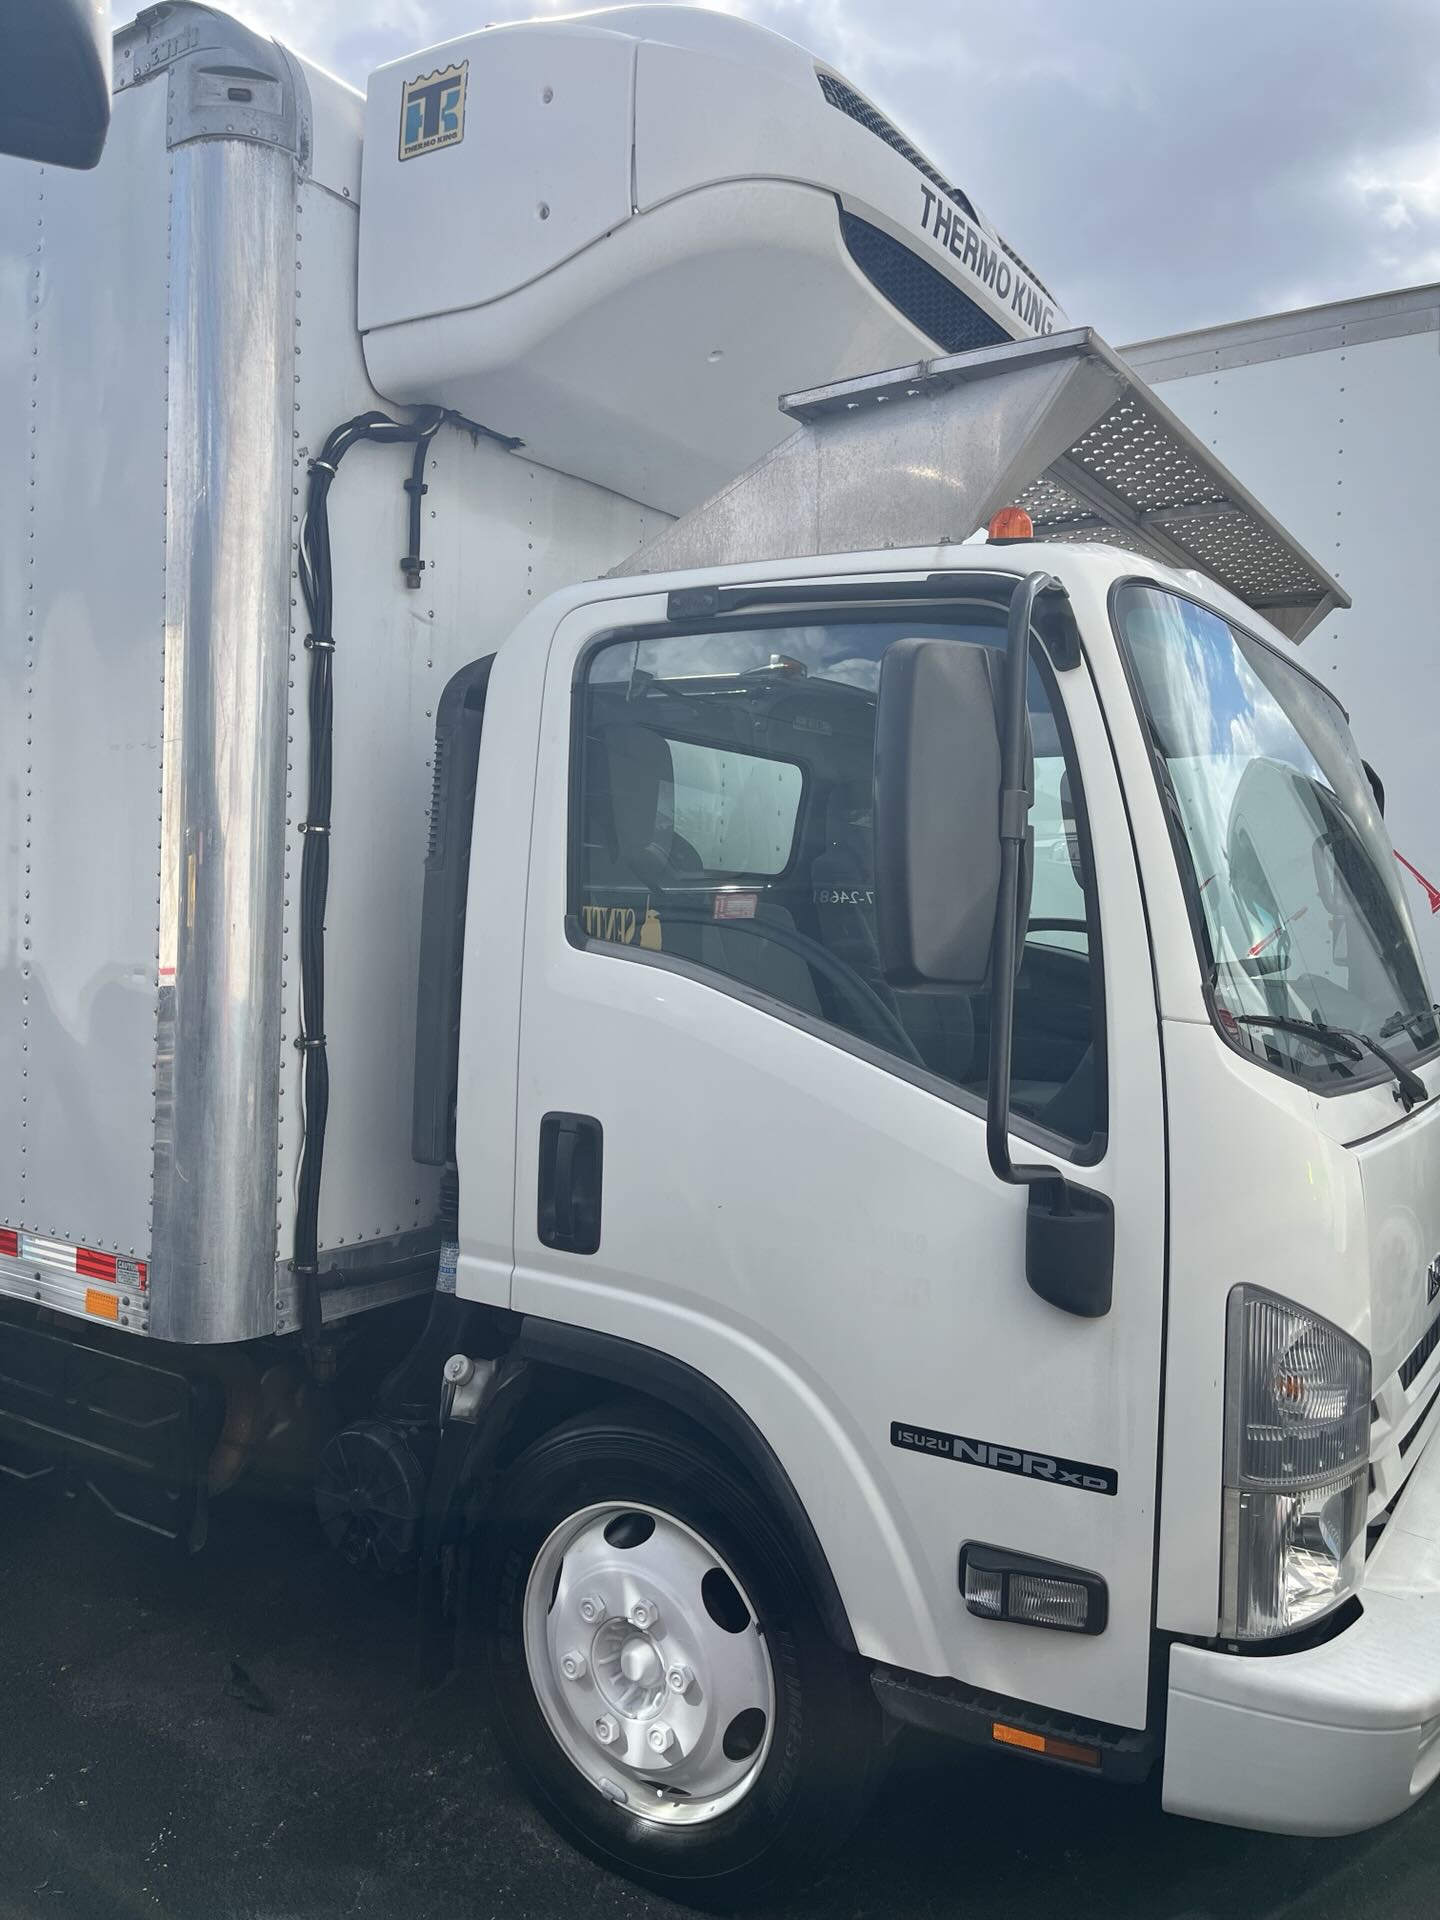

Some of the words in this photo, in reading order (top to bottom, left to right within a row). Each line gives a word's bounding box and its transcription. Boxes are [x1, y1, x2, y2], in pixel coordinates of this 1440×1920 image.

[404, 138, 436, 155] THERMO
[437, 132, 458, 145] KING
[920, 183, 1012, 300] THERMO
[1011, 275, 1055, 335] KING
[897, 1429, 950, 1452] ISUZU
